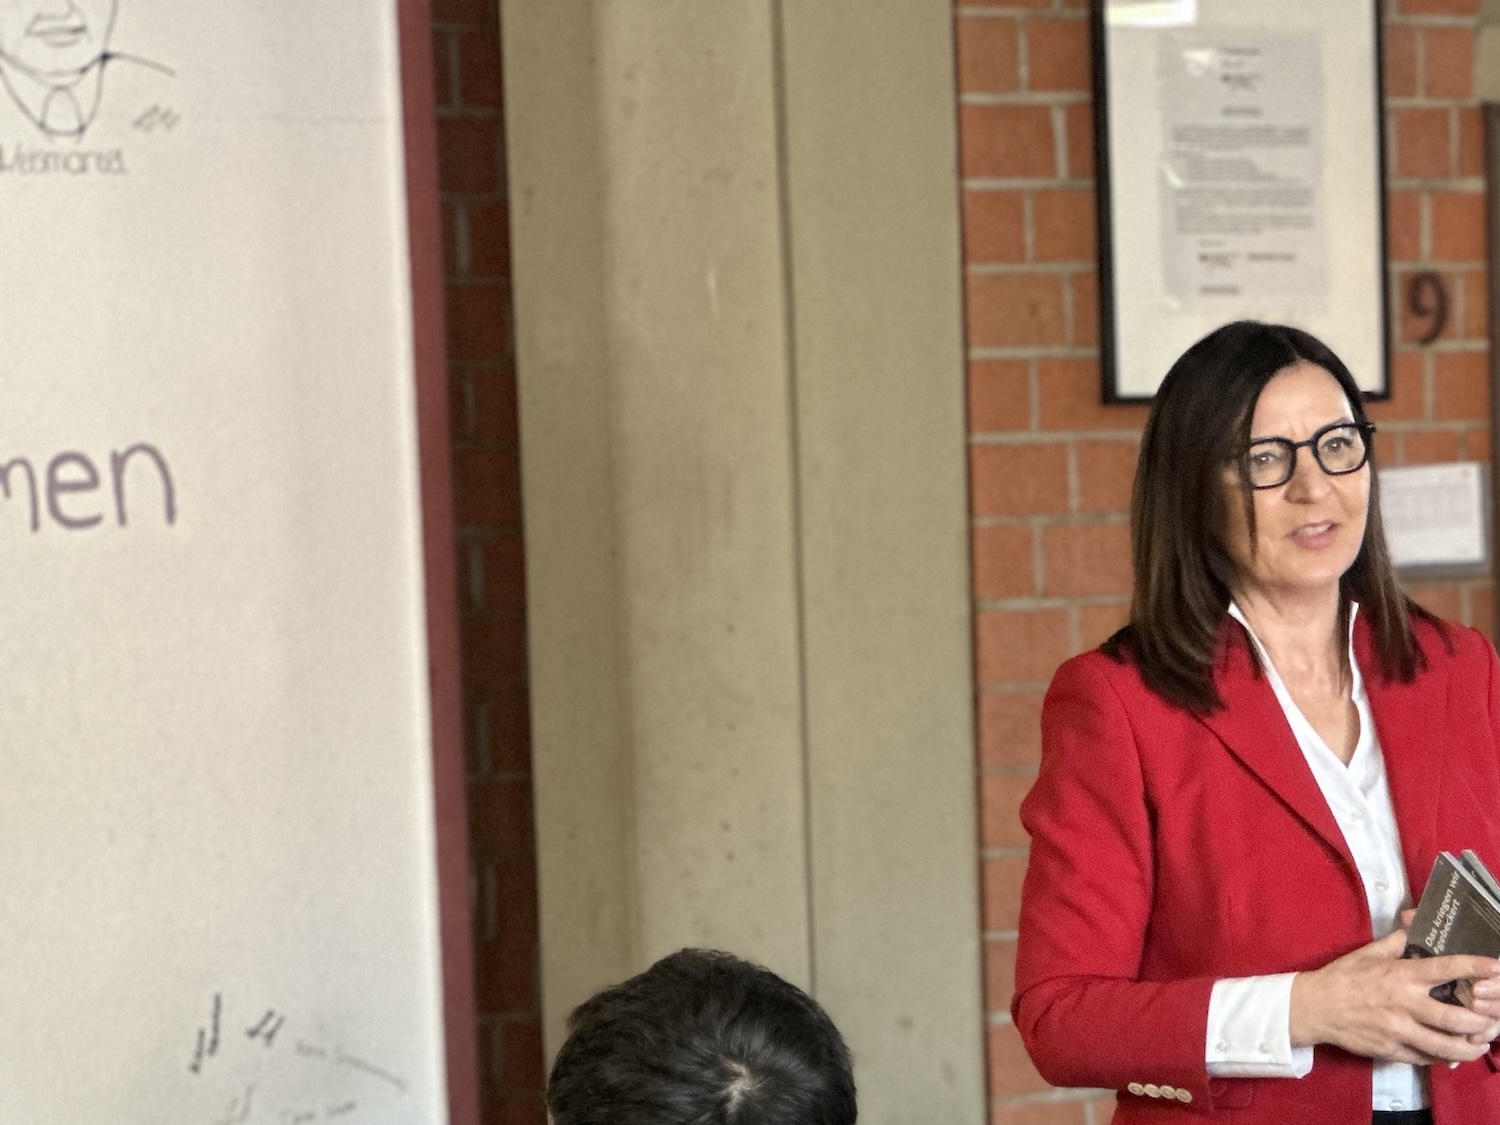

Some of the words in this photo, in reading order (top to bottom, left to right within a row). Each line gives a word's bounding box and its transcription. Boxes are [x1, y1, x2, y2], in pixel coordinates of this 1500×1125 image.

[1408, 270, 1449, 345] 9
[1425, 927, 1438, 948] Das
[1432, 888, 1454, 928] kriegen
[1448, 870, 1460, 889] wir
